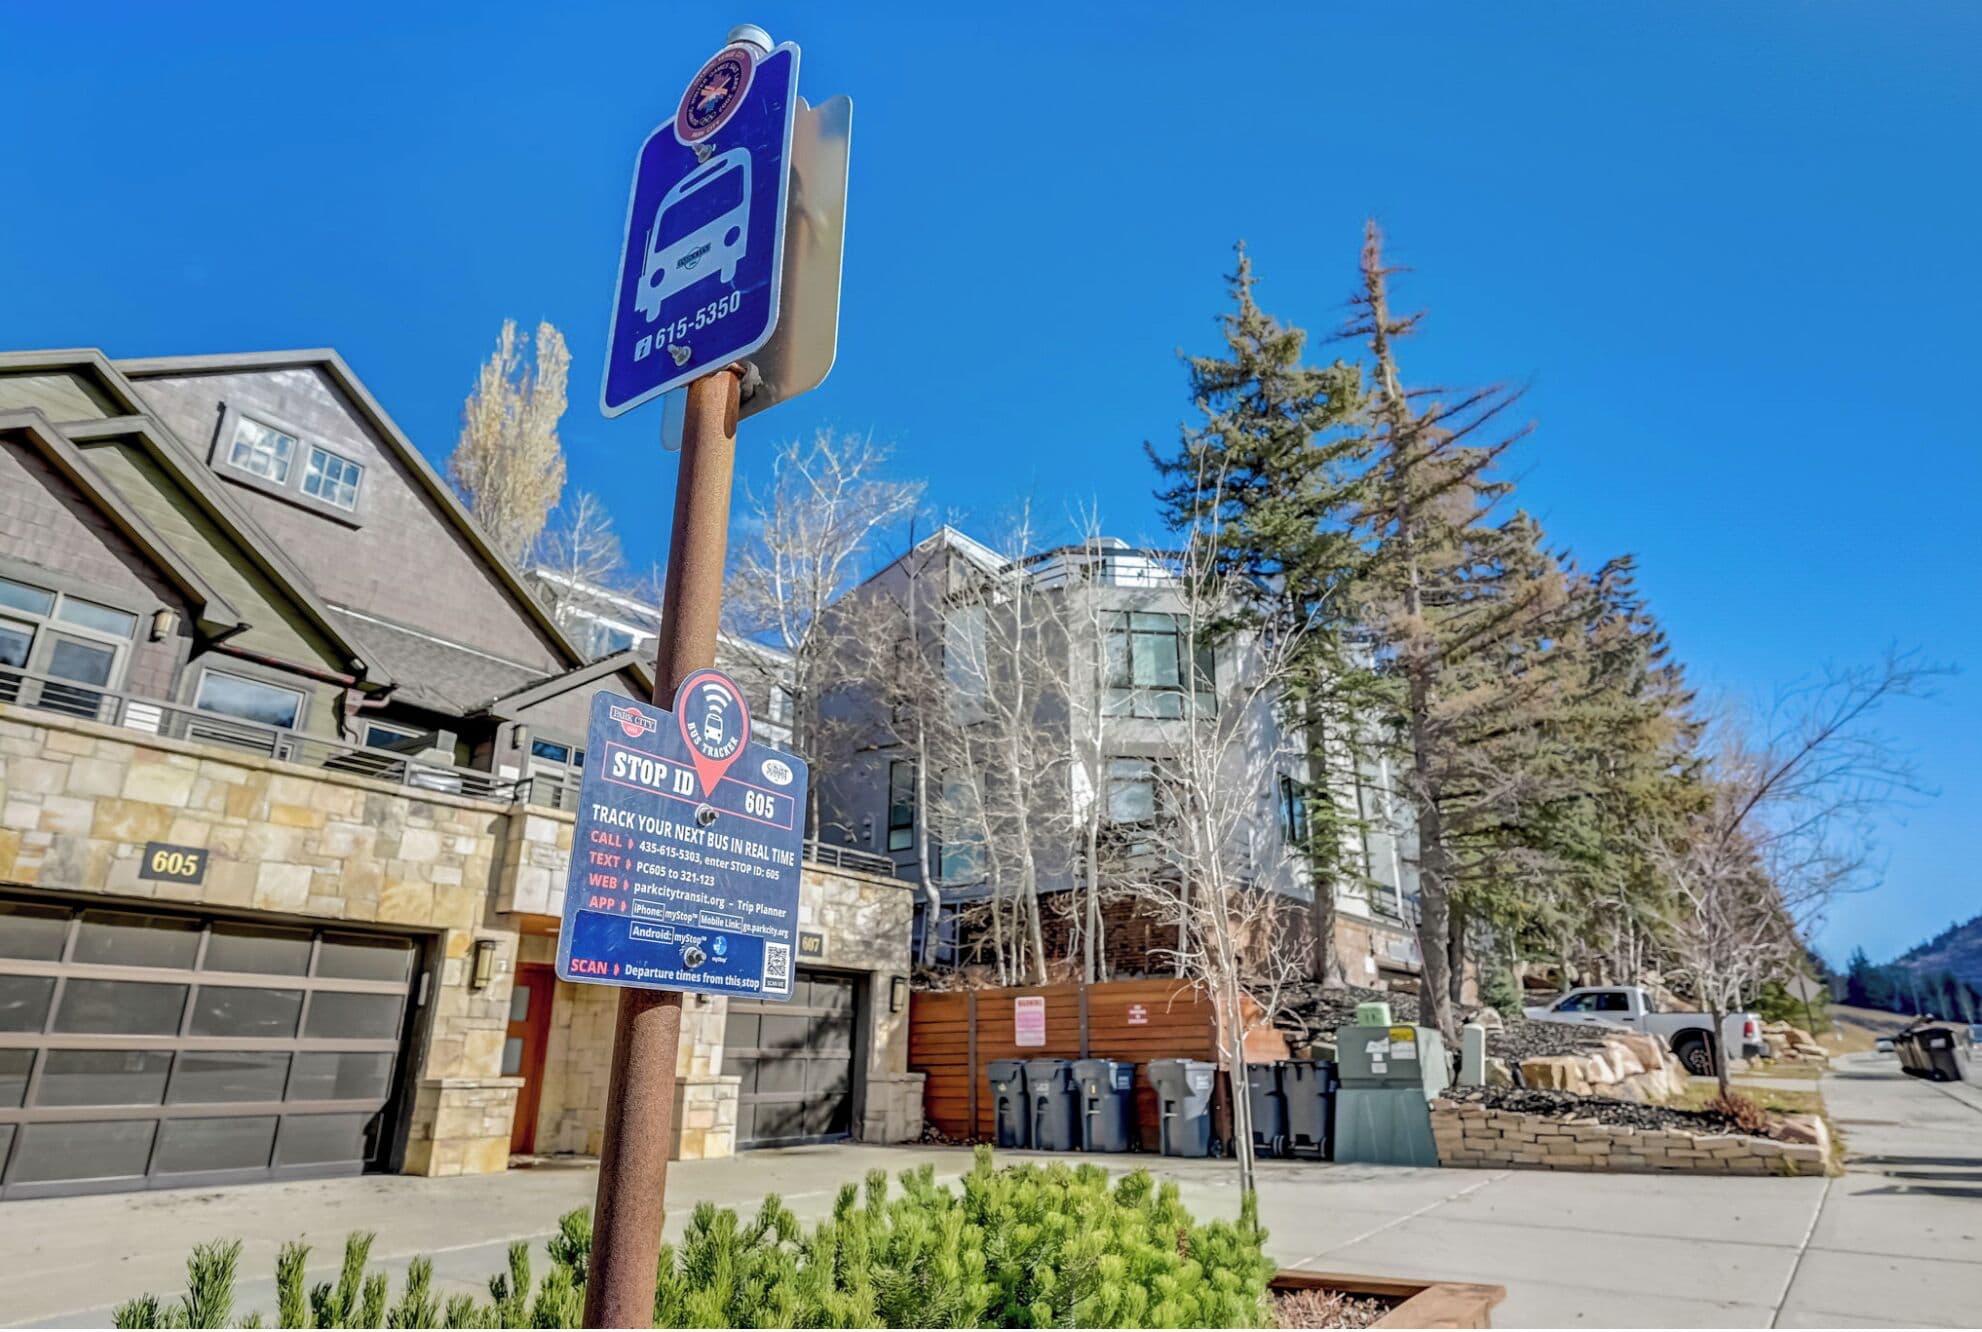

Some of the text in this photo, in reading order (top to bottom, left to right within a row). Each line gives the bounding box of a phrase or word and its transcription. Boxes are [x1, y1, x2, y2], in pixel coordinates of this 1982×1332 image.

[655, 290, 740, 349] 615-5350
[688, 722, 738, 758] BUS TRACKER
[612, 751, 775, 819] STOP ID 605
[590, 830, 780, 880] CALL 435-615-5303, enter STOP ID: 605
[592, 804, 795, 867] TRACK YOUR NEXT BUS IN REAL TIME
[151, 850, 199, 877] 605
[589, 851, 715, 886] TEXT PC605 to 321-123
[589, 873, 617, 889] WEB
[633, 882, 725, 909] parkcitytransit.org
[737, 899, 754, 914] Trip
[755, 902, 787, 918] Planner
[589, 895, 615, 910] APP
[634, 903, 662, 916] iPhone:
[701, 914, 724, 927] Mobile
[742, 922, 789, 939] go.parkcity.org
[632, 926, 672, 941] Android:
[570, 959, 760, 990] SCAN Departure times from this stop
